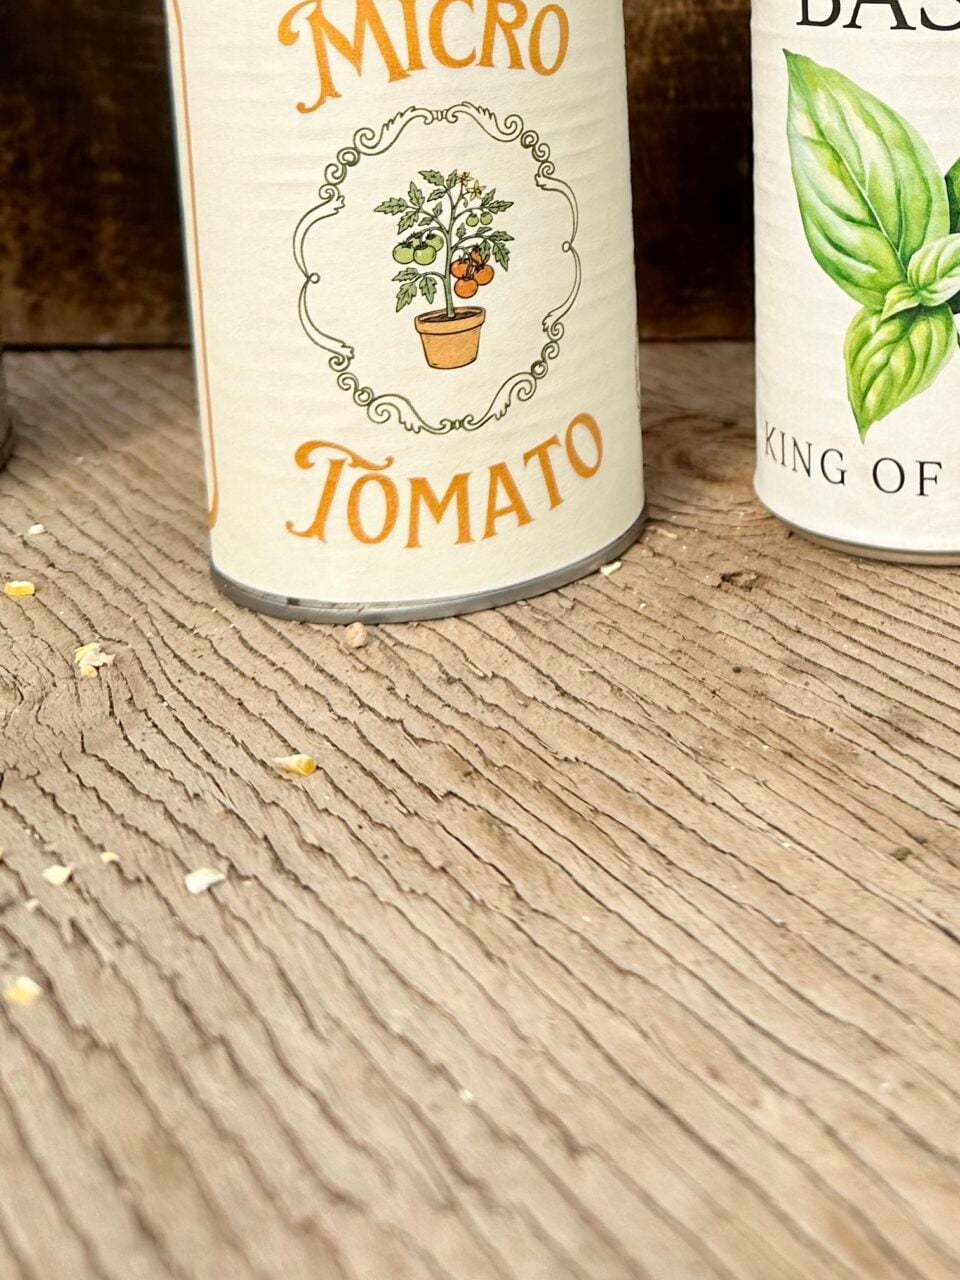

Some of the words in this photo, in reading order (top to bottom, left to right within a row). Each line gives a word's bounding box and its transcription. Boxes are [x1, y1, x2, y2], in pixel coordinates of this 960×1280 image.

[286, 412, 603, 548] TOMATO
[765, 421, 847, 486] KING
[872, 457, 942, 496] OF
